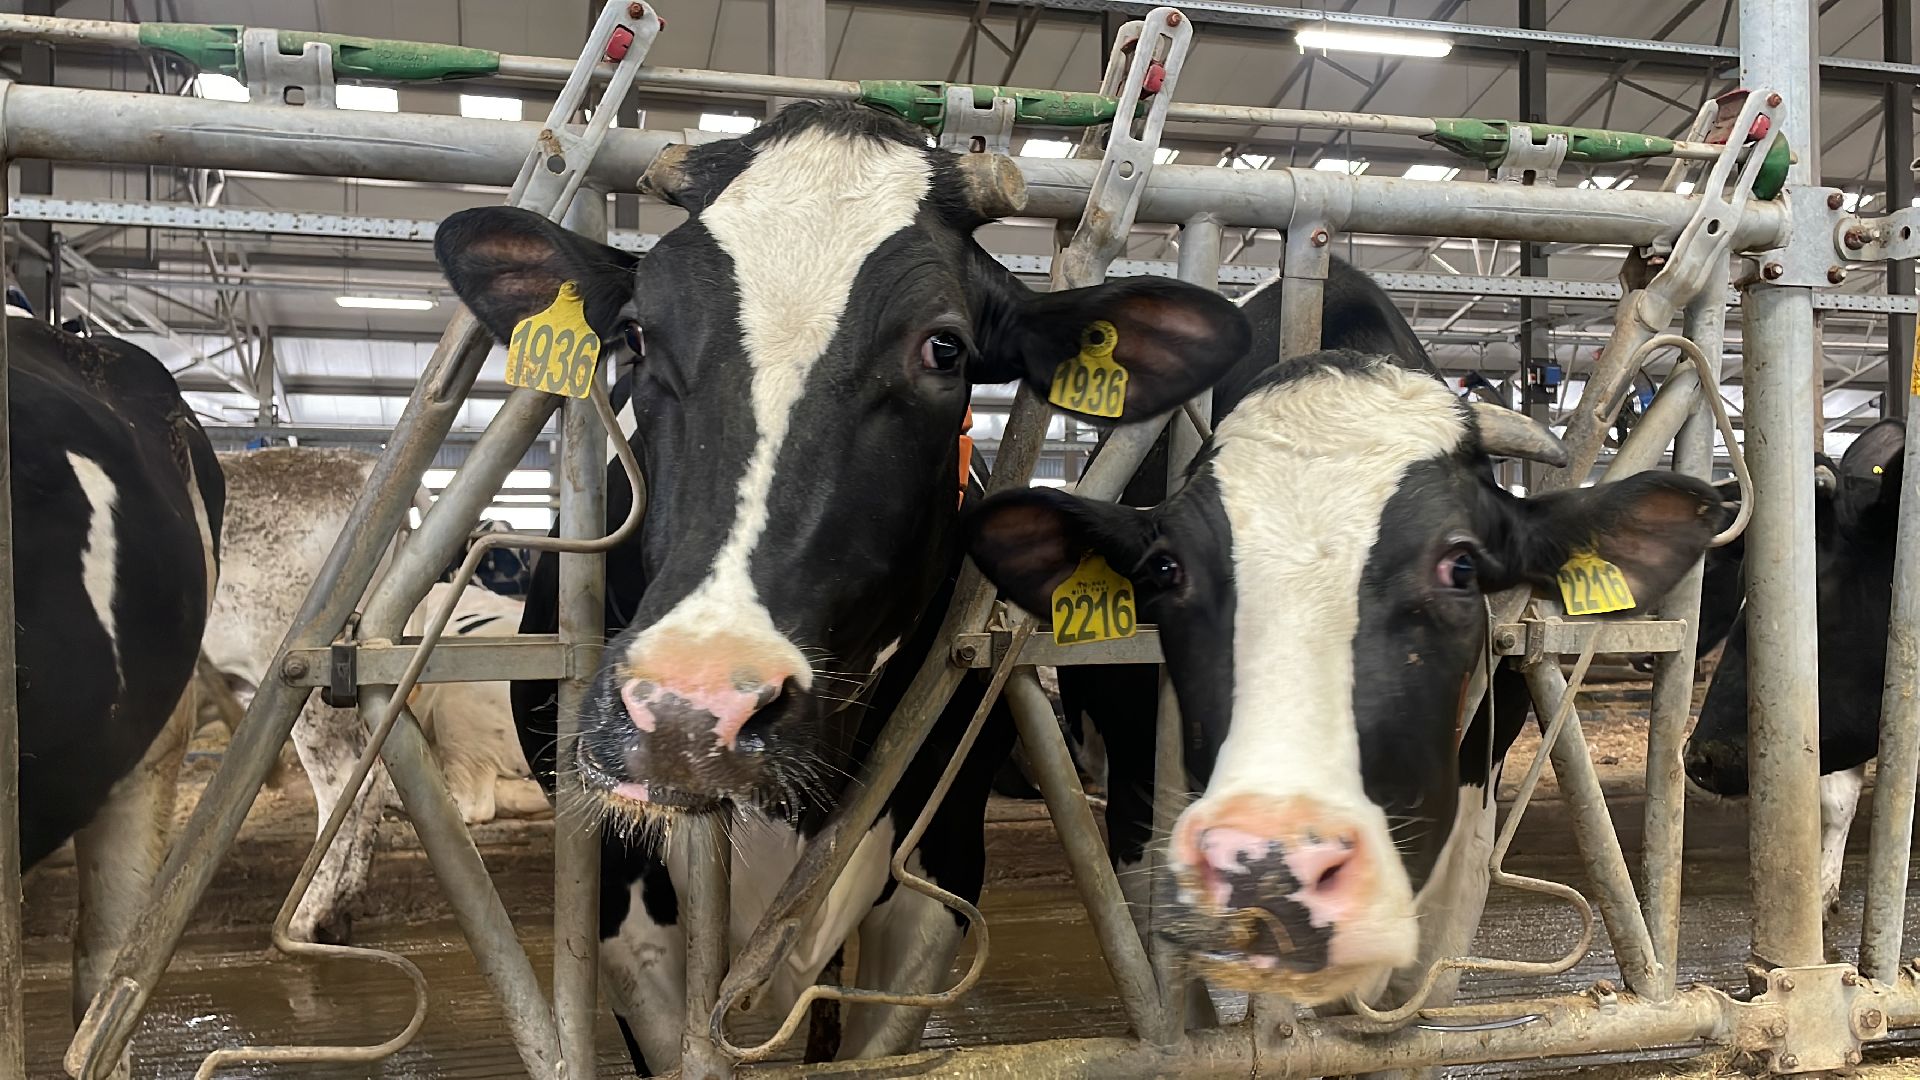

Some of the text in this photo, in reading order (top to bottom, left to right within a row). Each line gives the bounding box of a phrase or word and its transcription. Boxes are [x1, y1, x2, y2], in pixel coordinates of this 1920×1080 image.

[512, 320, 598, 396] 1936
[1056, 362, 1124, 414] 1936
[1560, 563, 1630, 612] 2216
[1055, 589, 1133, 644] 2216
